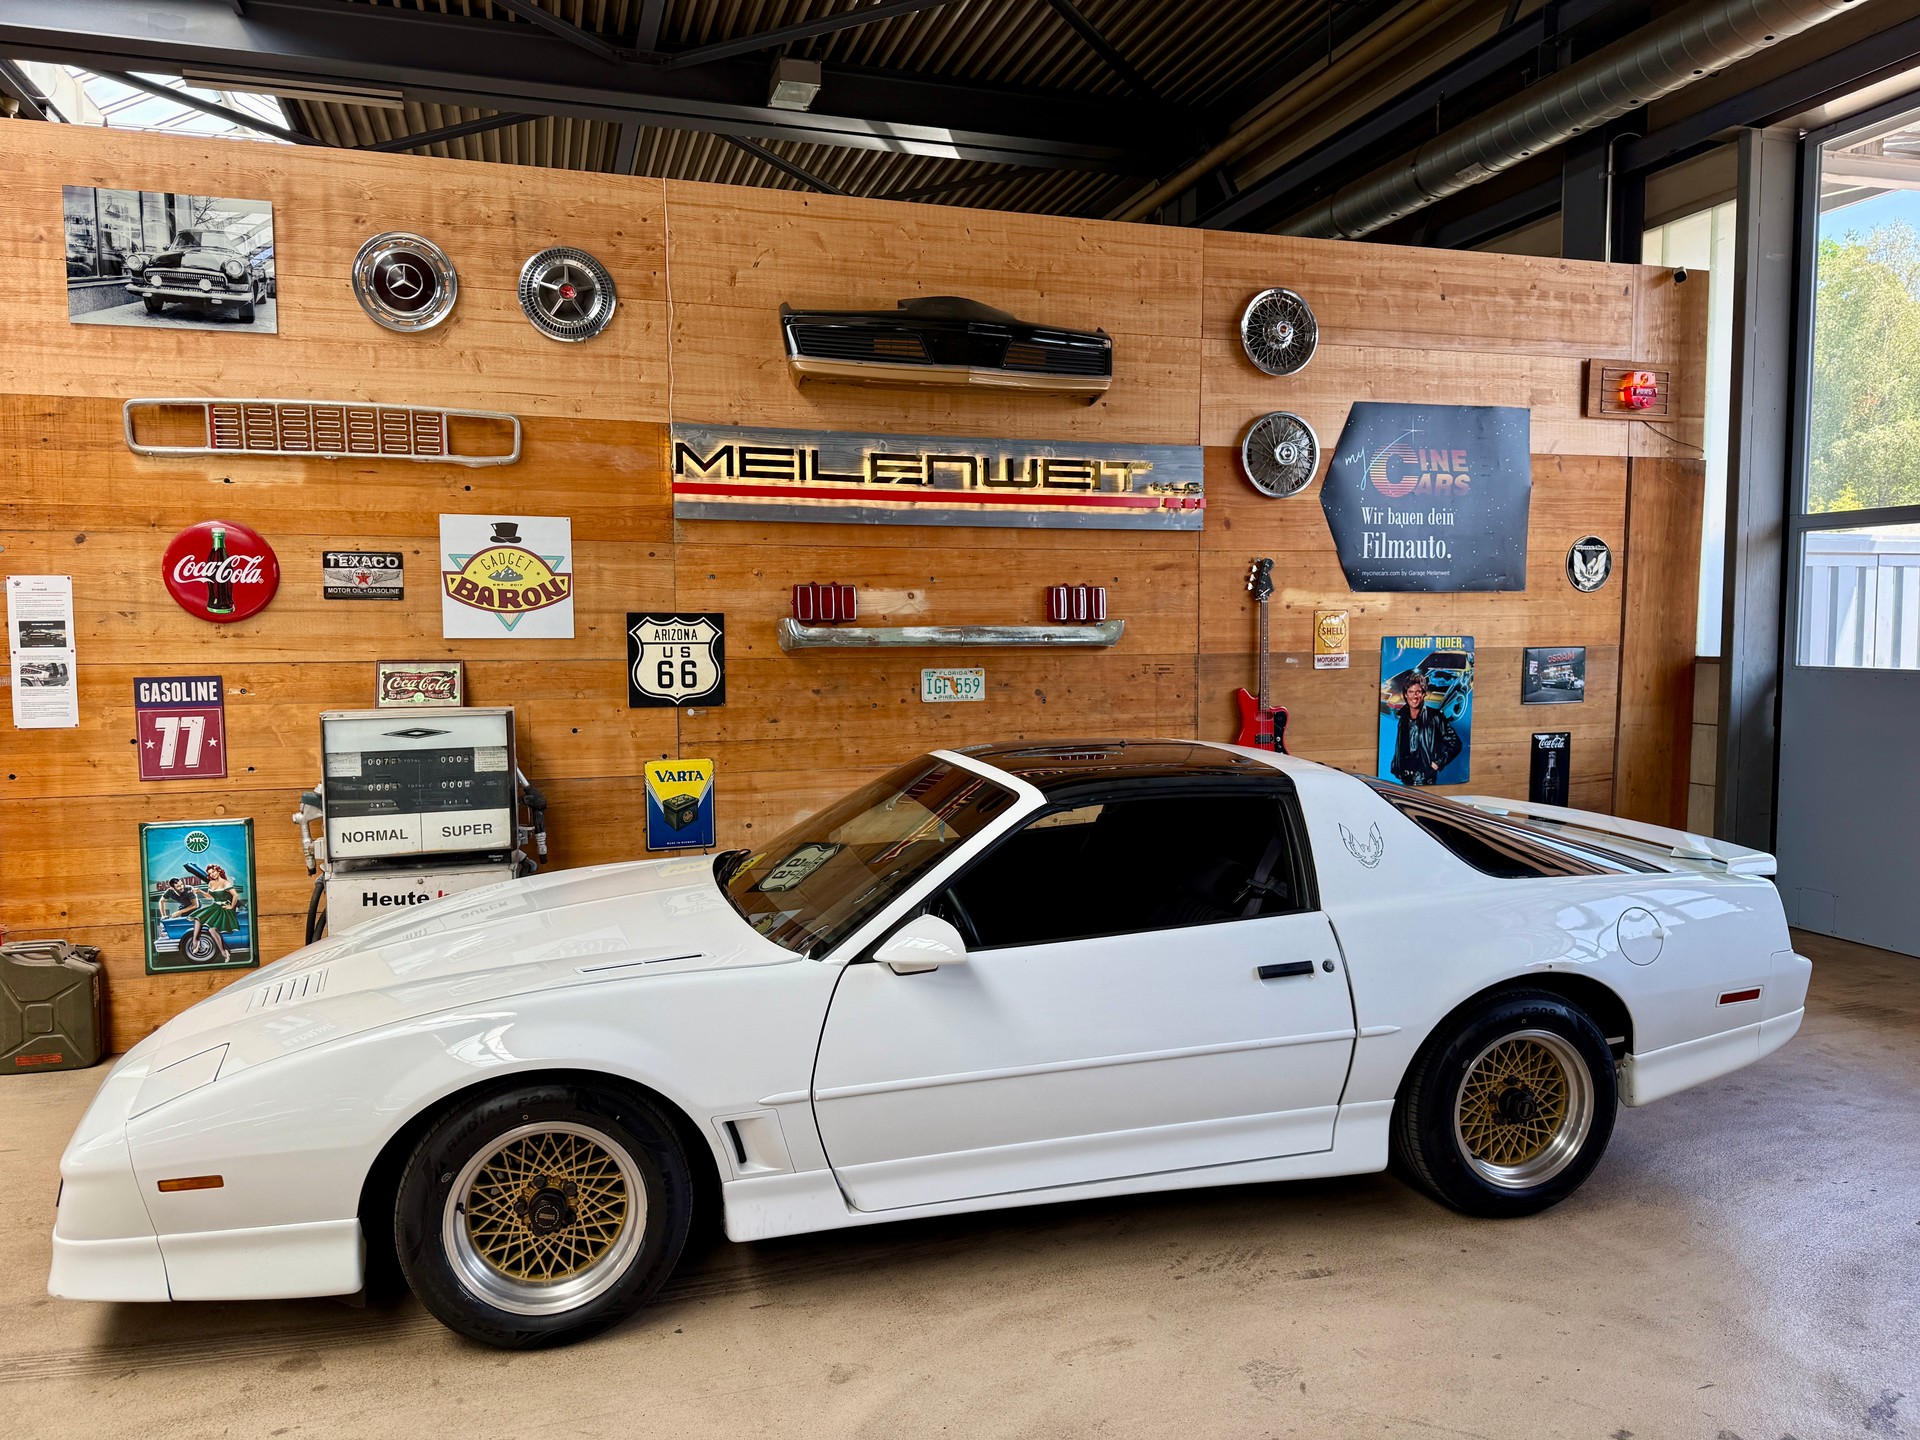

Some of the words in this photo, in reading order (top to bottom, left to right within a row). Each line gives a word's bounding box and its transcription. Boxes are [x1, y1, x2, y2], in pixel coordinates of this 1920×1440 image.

[675, 442, 1153, 492] MEILENWEIT
[1361, 506, 1384, 525] Wir
[1387, 507, 1424, 526] bauen
[1427, 507, 1454, 526] dein
[1362, 531, 1451, 559] Filmauto.
[173, 554, 264, 584] Coca-Cola
[326, 554, 399, 568] TEXACO
[480, 552, 534, 571] GADGET
[1361, 569, 1400, 577] mycinecars.com
[1401, 569, 1407, 577] by
[367, 587, 400, 595] GASOLINE
[451, 576, 567, 609] BARON
[654, 628, 698, 641] ARIZONA
[1322, 627, 1344, 636] SHELL
[1396, 637, 1432, 649] KNIGHT
[1547, 651, 1575, 663] OSRAM
[386, 675, 454, 691] Coca-Cola
[657, 660, 697, 689] 66
[140, 681, 218, 703] GASOLINE
[155, 716, 206, 769] 77
[655, 769, 705, 783] VARTA
[341, 828, 409, 844] NORMAL
[441, 823, 493, 838] SUPER
[362, 890, 430, 907] Heute
